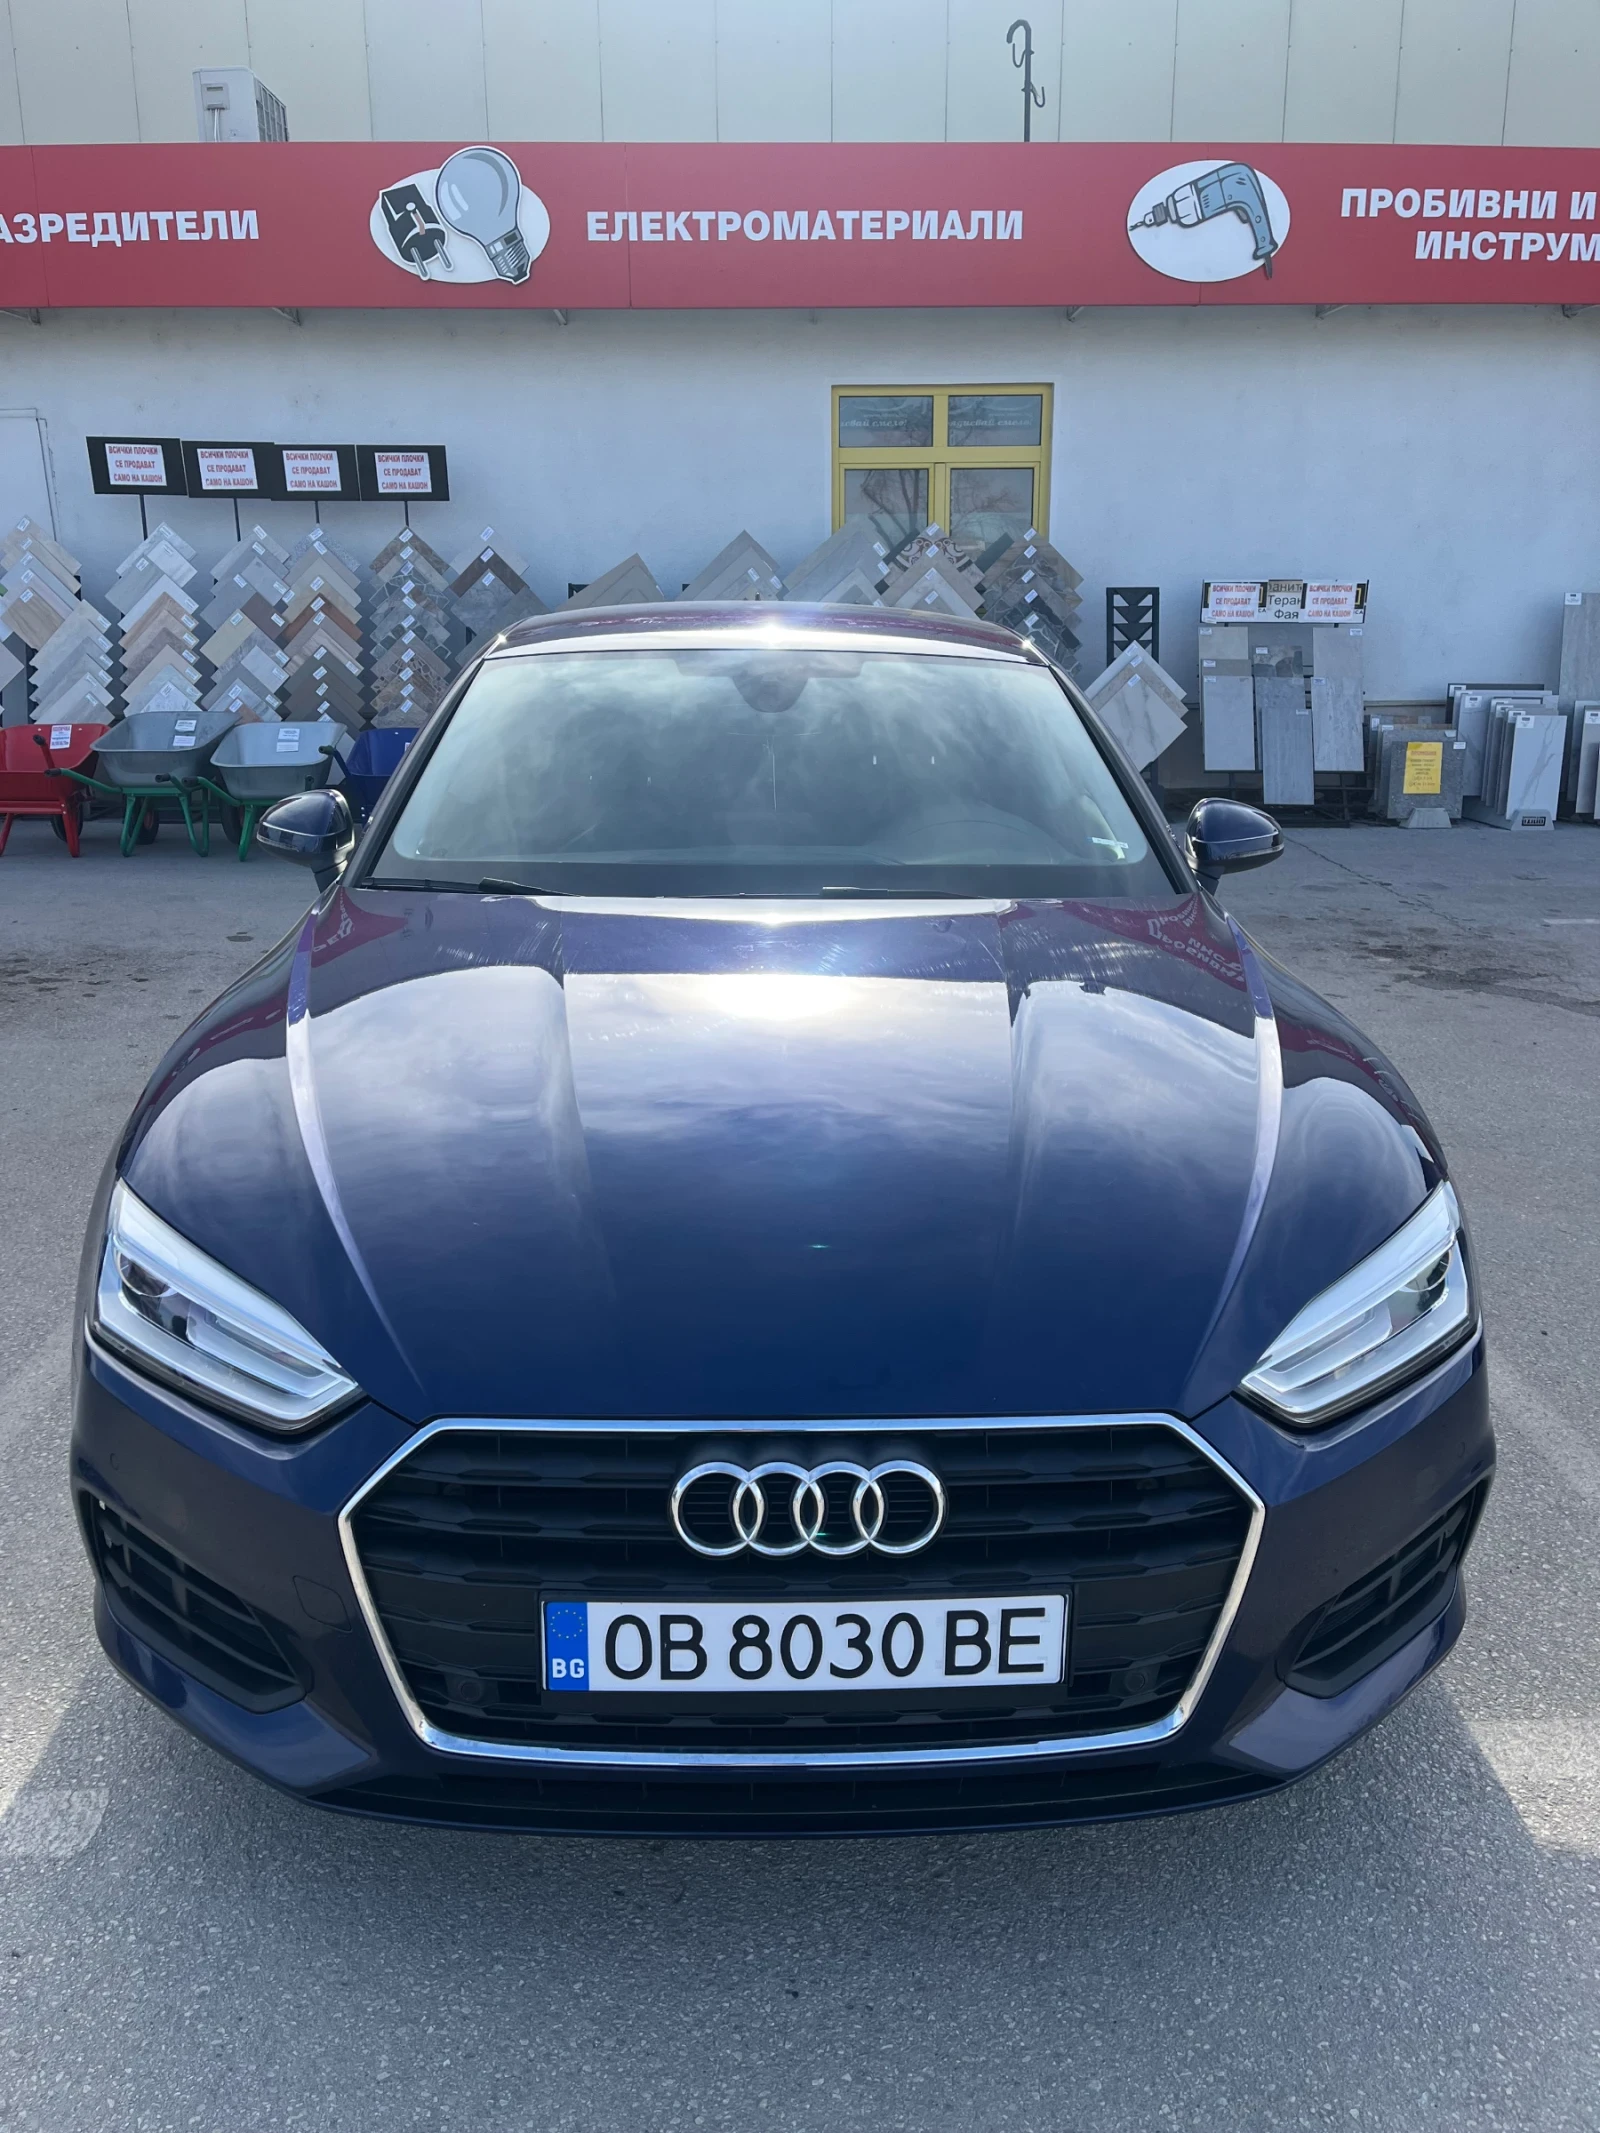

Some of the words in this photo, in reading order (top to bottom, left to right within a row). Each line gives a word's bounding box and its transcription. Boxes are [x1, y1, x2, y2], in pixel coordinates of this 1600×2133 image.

[1340, 188, 1557, 219] ПРОБИВНИ
[1569, 191, 1597, 220] И
[586, 209, 1023, 242] ЕЛЕКТРОМАТЕРИАЛИ
[1415, 230, 1600, 261] ИНСТРУМ
[108, 445, 133, 455] ВСИЧКИ
[133, 446, 159, 455] ПЛОЧКИ
[200, 451, 224, 459] ВСИЧКИ
[224, 451, 249, 459] ПЛОЧКИ
[286, 453, 309, 461] ВСИЧКИ
[310, 453, 334, 461] ПЛОЧКИ
[378, 455, 401, 463] ВСИЧКИ
[401, 455, 425, 463] ПЛОЧКИ
[115, 460, 123, 468] СЕ
[124, 460, 155, 470] ПРОДАВАТ
[216, 465, 246, 474] ПРОДАВАТ
[301, 467, 330, 475] ПРОДАВАТ
[383, 468, 392, 476] СЕ
[392, 468, 421, 477] ПРОДАВАТ
[113, 474, 131, 482] САМО
[131, 474, 141, 482] НА
[205, 478, 222, 486] САМО
[223, 478, 232, 486] НА
[290, 480, 307, 488] САМО
[307, 480, 316, 488] НА
[604, 1613, 708, 1681] OB
[729, 1612, 924, 1680] 8030
[943, 1607, 1046, 1676] BE
[551, 1658, 585, 1679] BG
